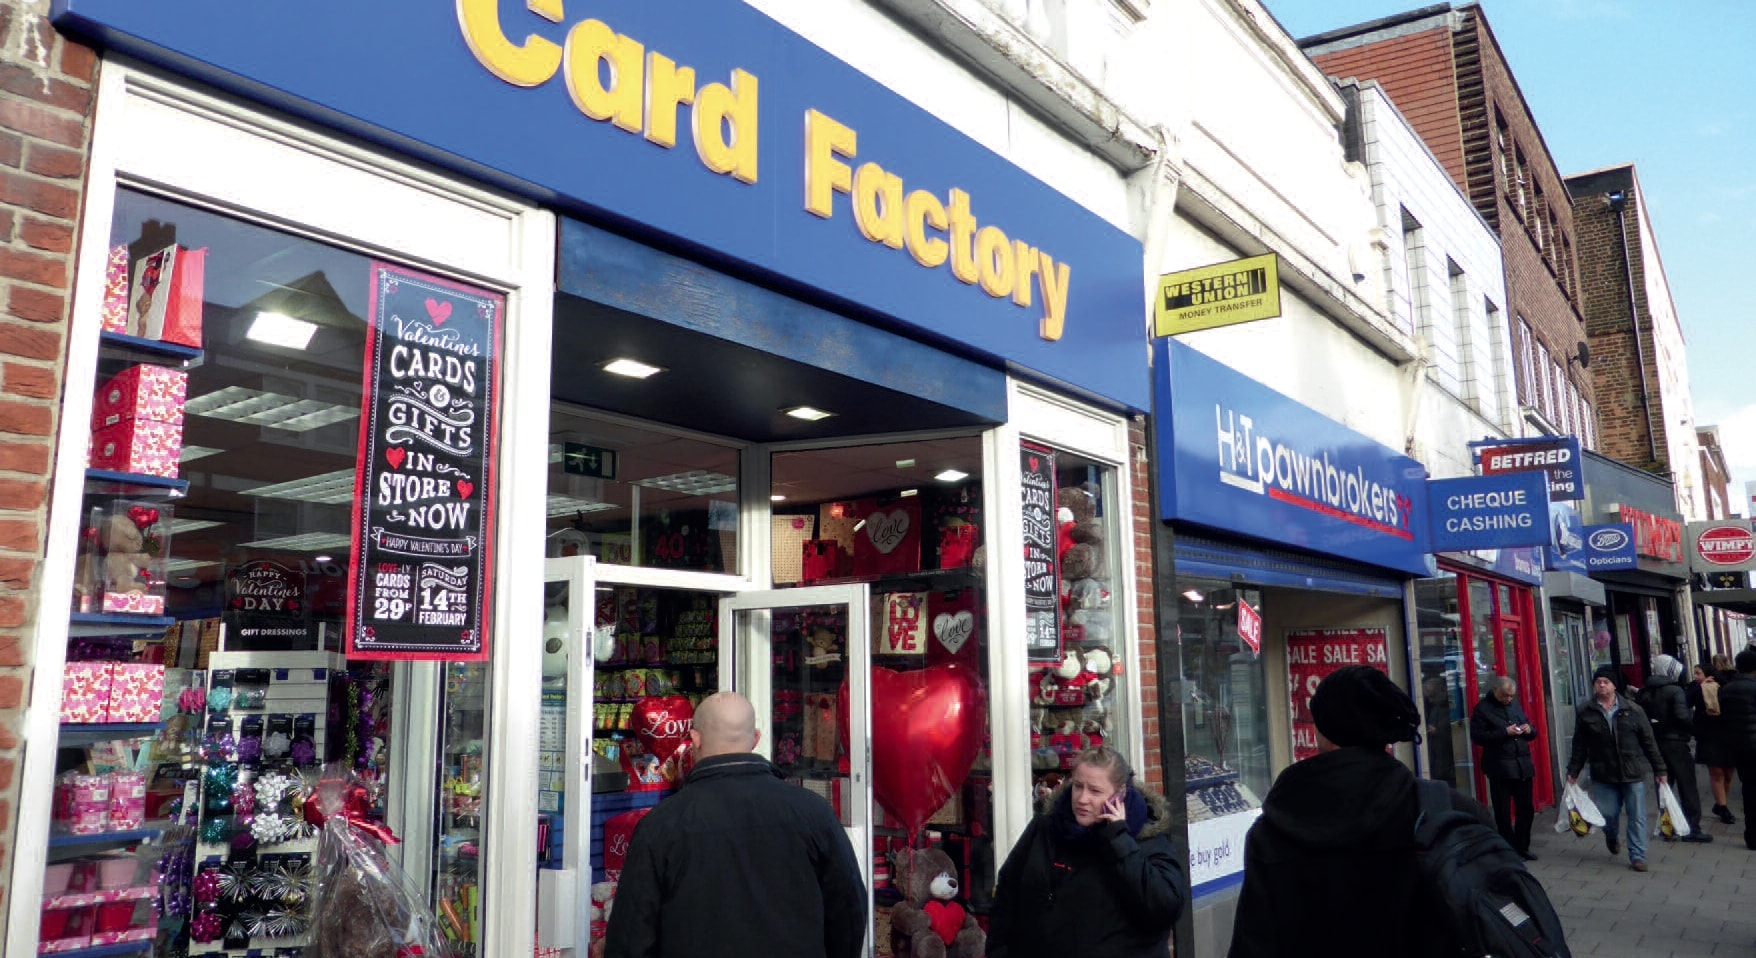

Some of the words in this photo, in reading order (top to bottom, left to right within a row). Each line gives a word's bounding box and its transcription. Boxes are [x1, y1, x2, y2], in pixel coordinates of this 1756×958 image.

[456, 0, 759, 185] Card
[804, 107, 1070, 342] Factory
[1165, 271, 1249, 299] WESTERN
[1191, 284, 1249, 306] UNION
[1179, 308, 1211, 320] MONEY
[1215, 298, 1263, 313] TRANSFER
[391, 345, 476, 394] CARDS
[389, 402, 472, 447] GIFTS
[406, 451, 434, 472] IN
[1491, 449, 1571, 470] BETFRED
[1553, 469, 1573, 480] the
[379, 472, 451, 505] STORE
[1547, 481, 1575, 493] ing
[1447, 490, 1527, 510] CHEQUE
[408, 502, 471, 529] NOW
[1446, 513, 1532, 532] CASHING
[385, 537, 409, 550] HAPPY
[450, 543, 463, 553] DAY
[1699, 540, 1753, 551] WIMPY
[1589, 556, 1633, 566] Opticians
[249, 571, 281, 579] HAPPY
[375, 573, 411, 588] CARDS
[422, 568, 468, 586] SATURDAY
[243, 597, 284, 610] DAY
[375, 588, 409, 599] FROM
[419, 612, 467, 625] FEBRUARY
[1241, 608, 1259, 643] SALE
[241, 628, 259, 636] GIFT
[260, 628, 307, 636] DRESSINGS
[1323, 643, 1360, 663] SALE
[1197, 846, 1210, 868] buy
